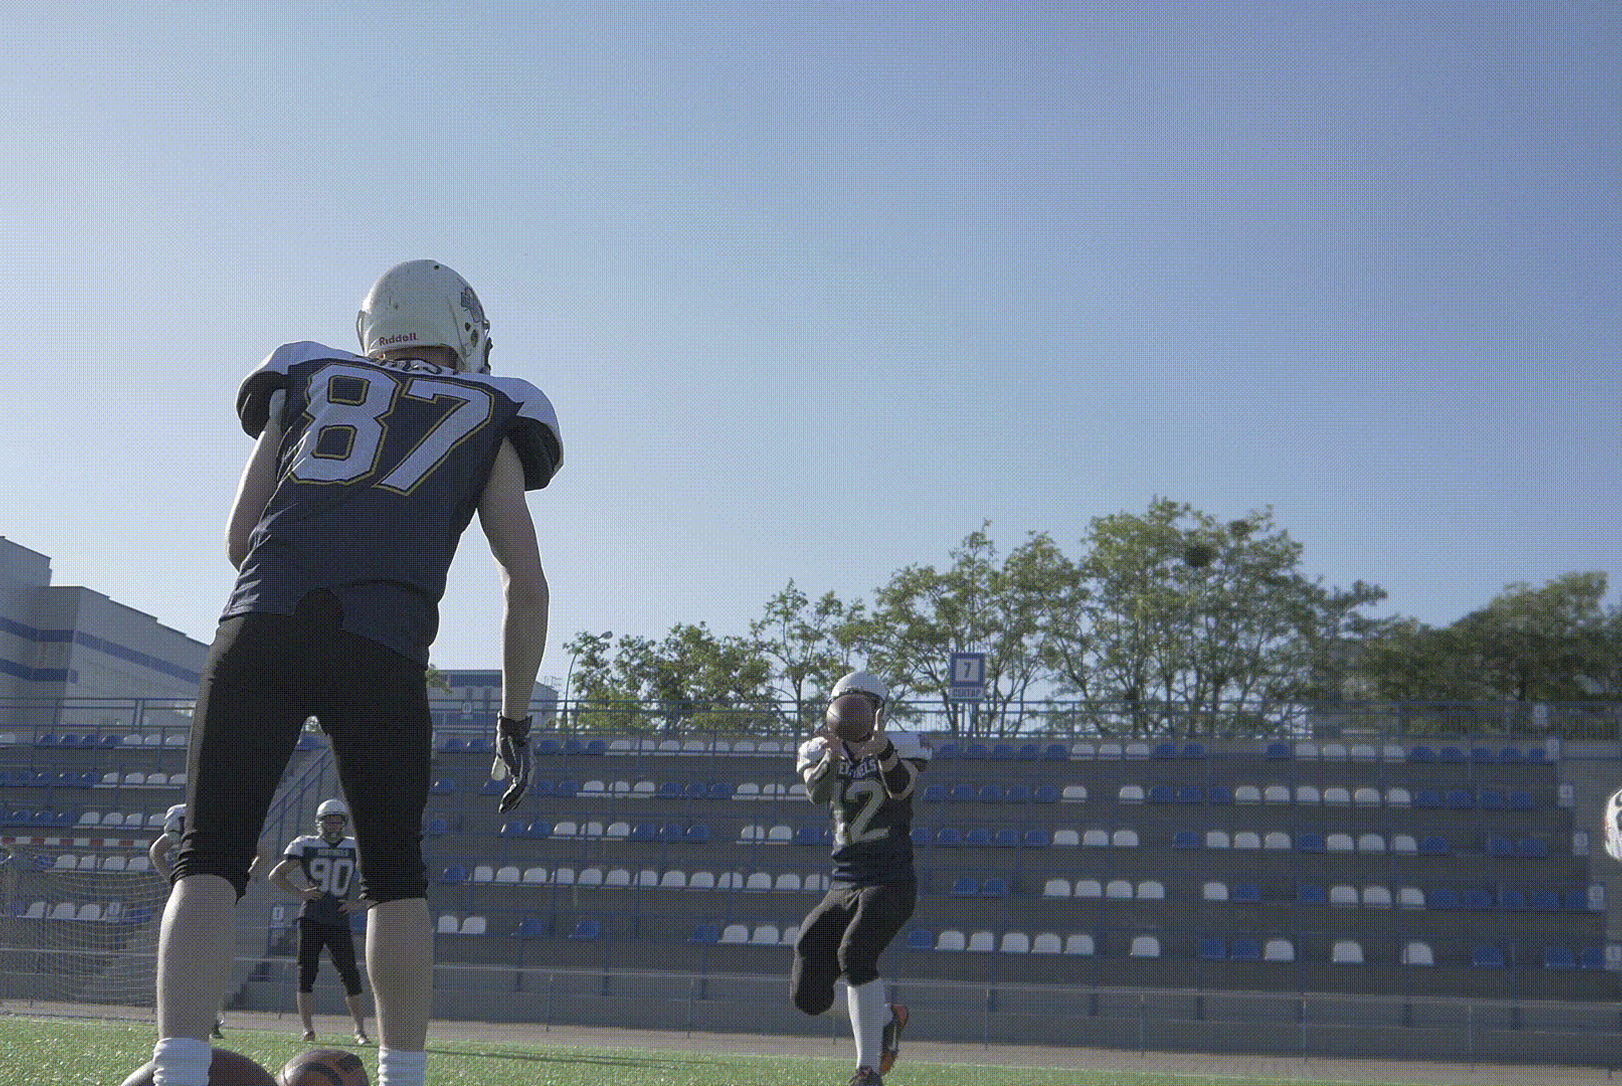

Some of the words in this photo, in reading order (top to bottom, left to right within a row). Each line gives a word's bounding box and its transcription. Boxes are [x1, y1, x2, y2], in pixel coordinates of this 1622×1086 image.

[378, 332, 417, 346] Riddell
[288, 362, 495, 496] 87
[963, 662, 972, 679] 7
[309, 858, 354, 897] 90
